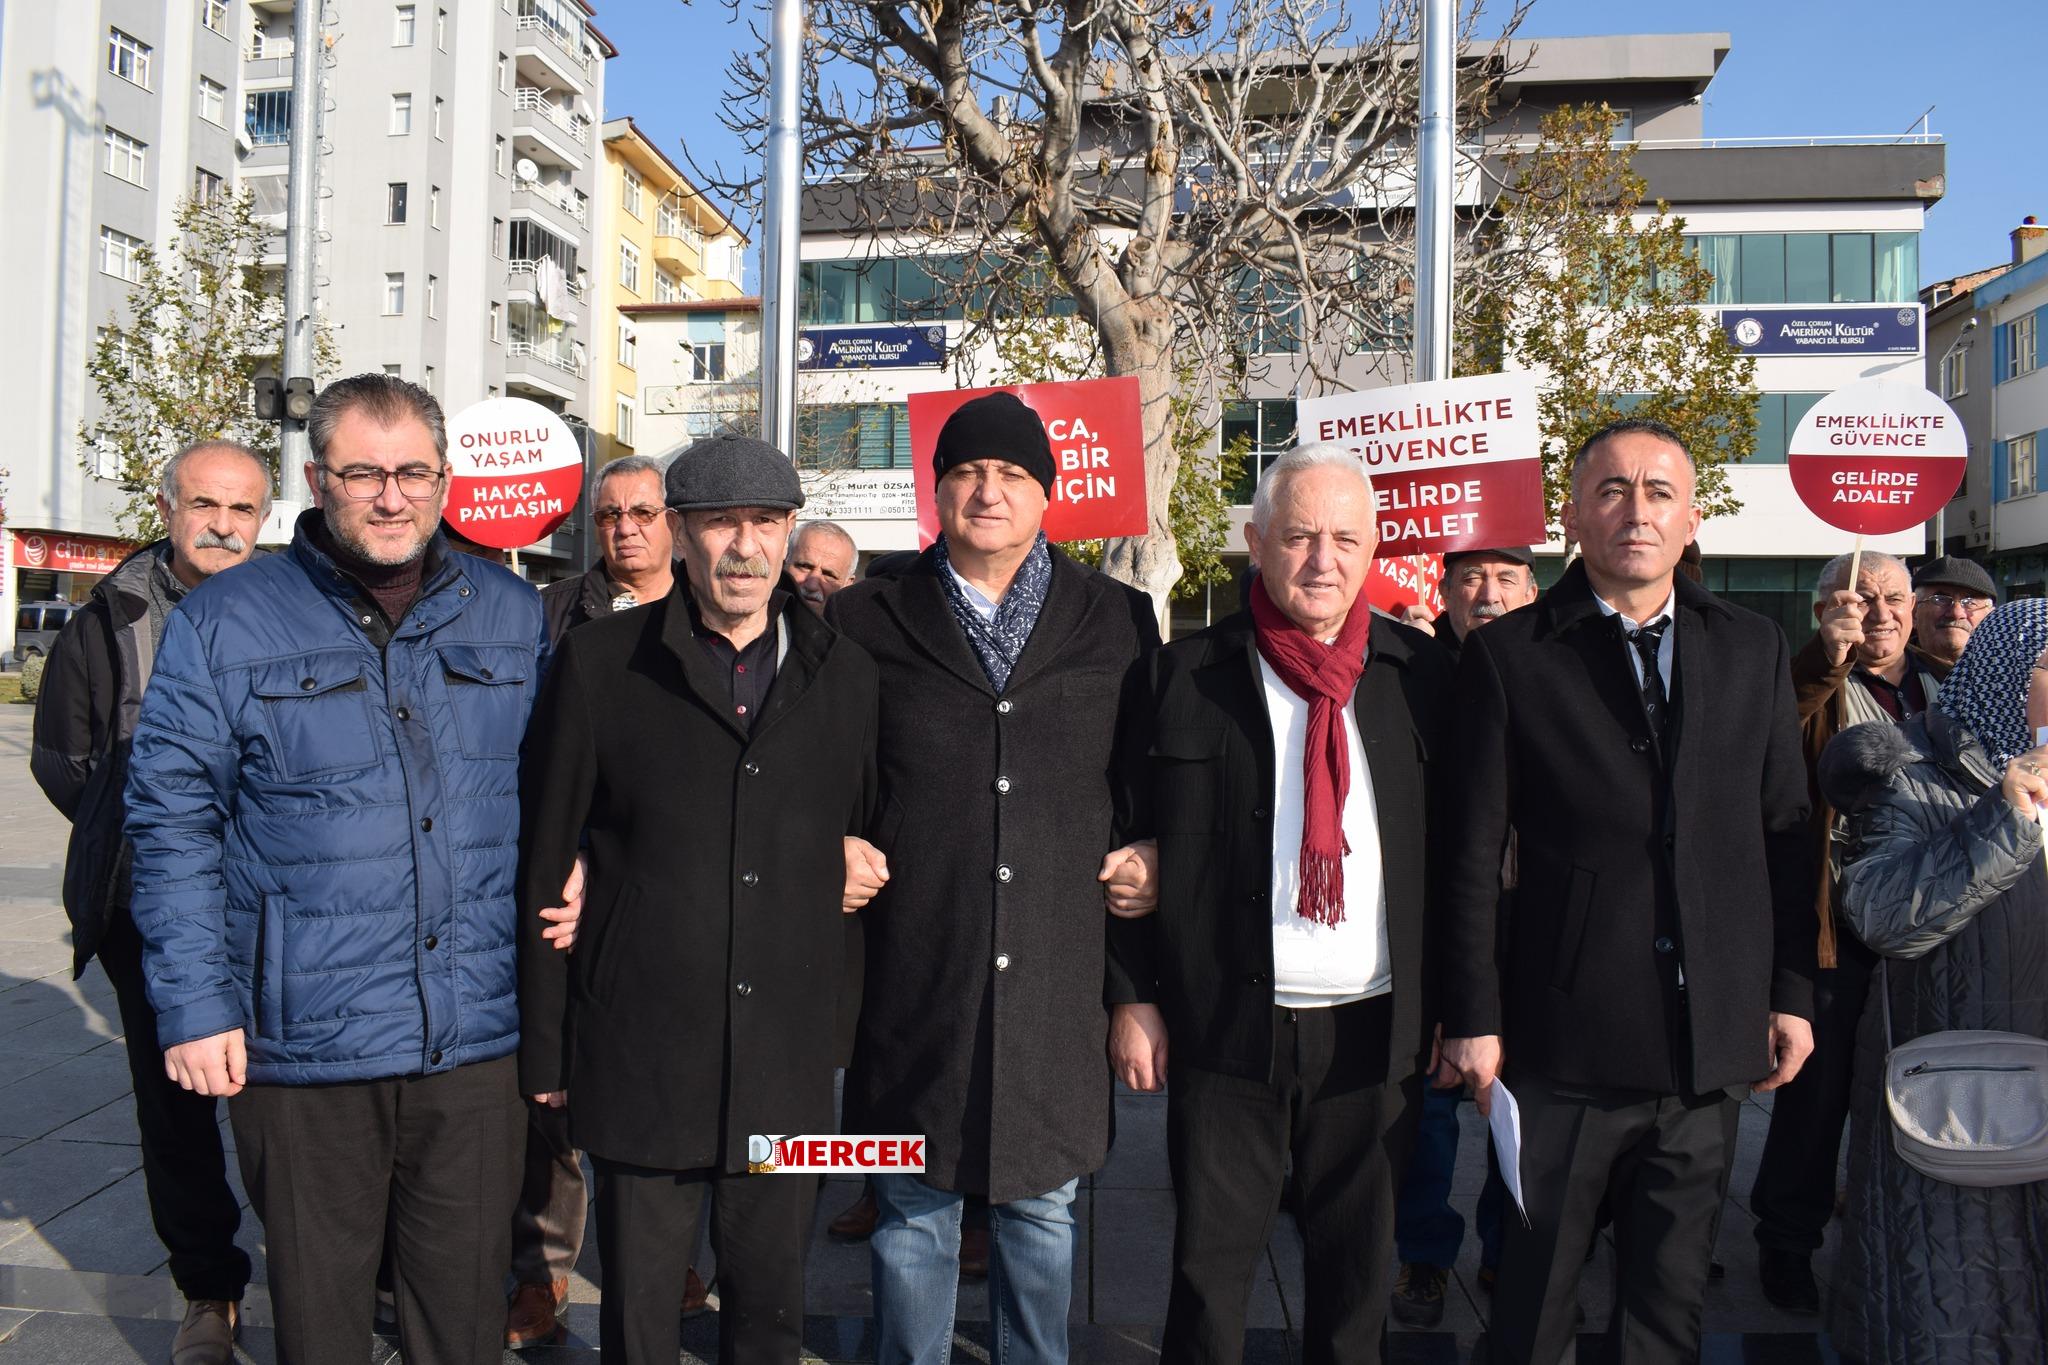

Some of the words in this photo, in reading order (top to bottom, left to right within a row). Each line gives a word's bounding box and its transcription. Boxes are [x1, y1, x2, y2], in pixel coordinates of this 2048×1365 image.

[1042, 417, 1099, 442] CA,
[1319, 397, 1513, 441] EMEKLİLİKTE
[1815, 413, 1945, 429] EMEKLİLİKTE
[460, 427, 549, 449] ONURLU
[1830, 430, 1926, 447] GÜVENCE
[470, 448, 543, 469] YAŞAM
[1061, 443, 1110, 471] BİR
[1055, 473, 1116, 504] İÇİN
[1831, 469, 1919, 487] GELİRDE
[473, 482, 547, 503] HAKÇA
[1374, 480, 1483, 512] ELİRDE
[1832, 489, 1915, 505] ADALET
[459, 498, 563, 523] PAYLAŞIM
[1379, 512, 1480, 543] DALET
